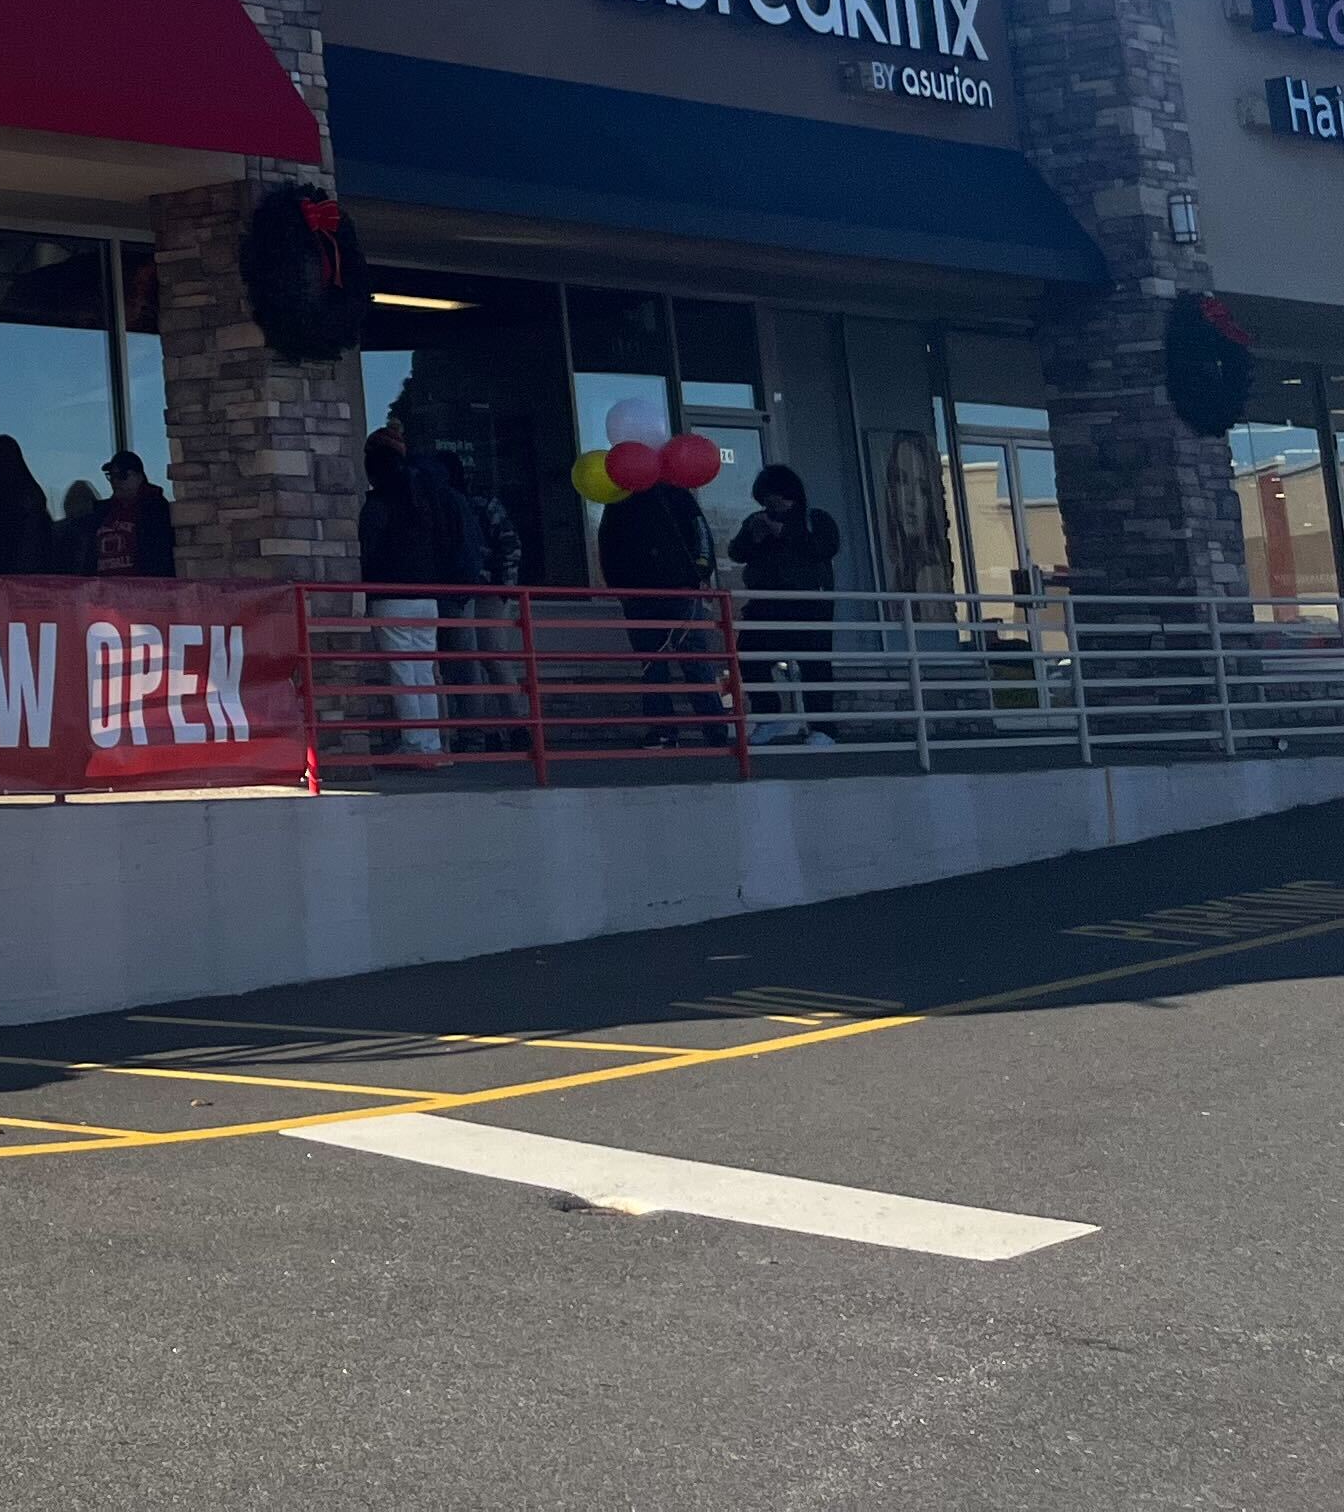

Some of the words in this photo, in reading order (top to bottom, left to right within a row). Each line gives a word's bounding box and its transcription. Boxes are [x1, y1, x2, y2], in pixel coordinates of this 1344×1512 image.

[871, 61, 895, 92] BY
[902, 65, 994, 109] asurion
[85, 621, 251, 750] OPEN
